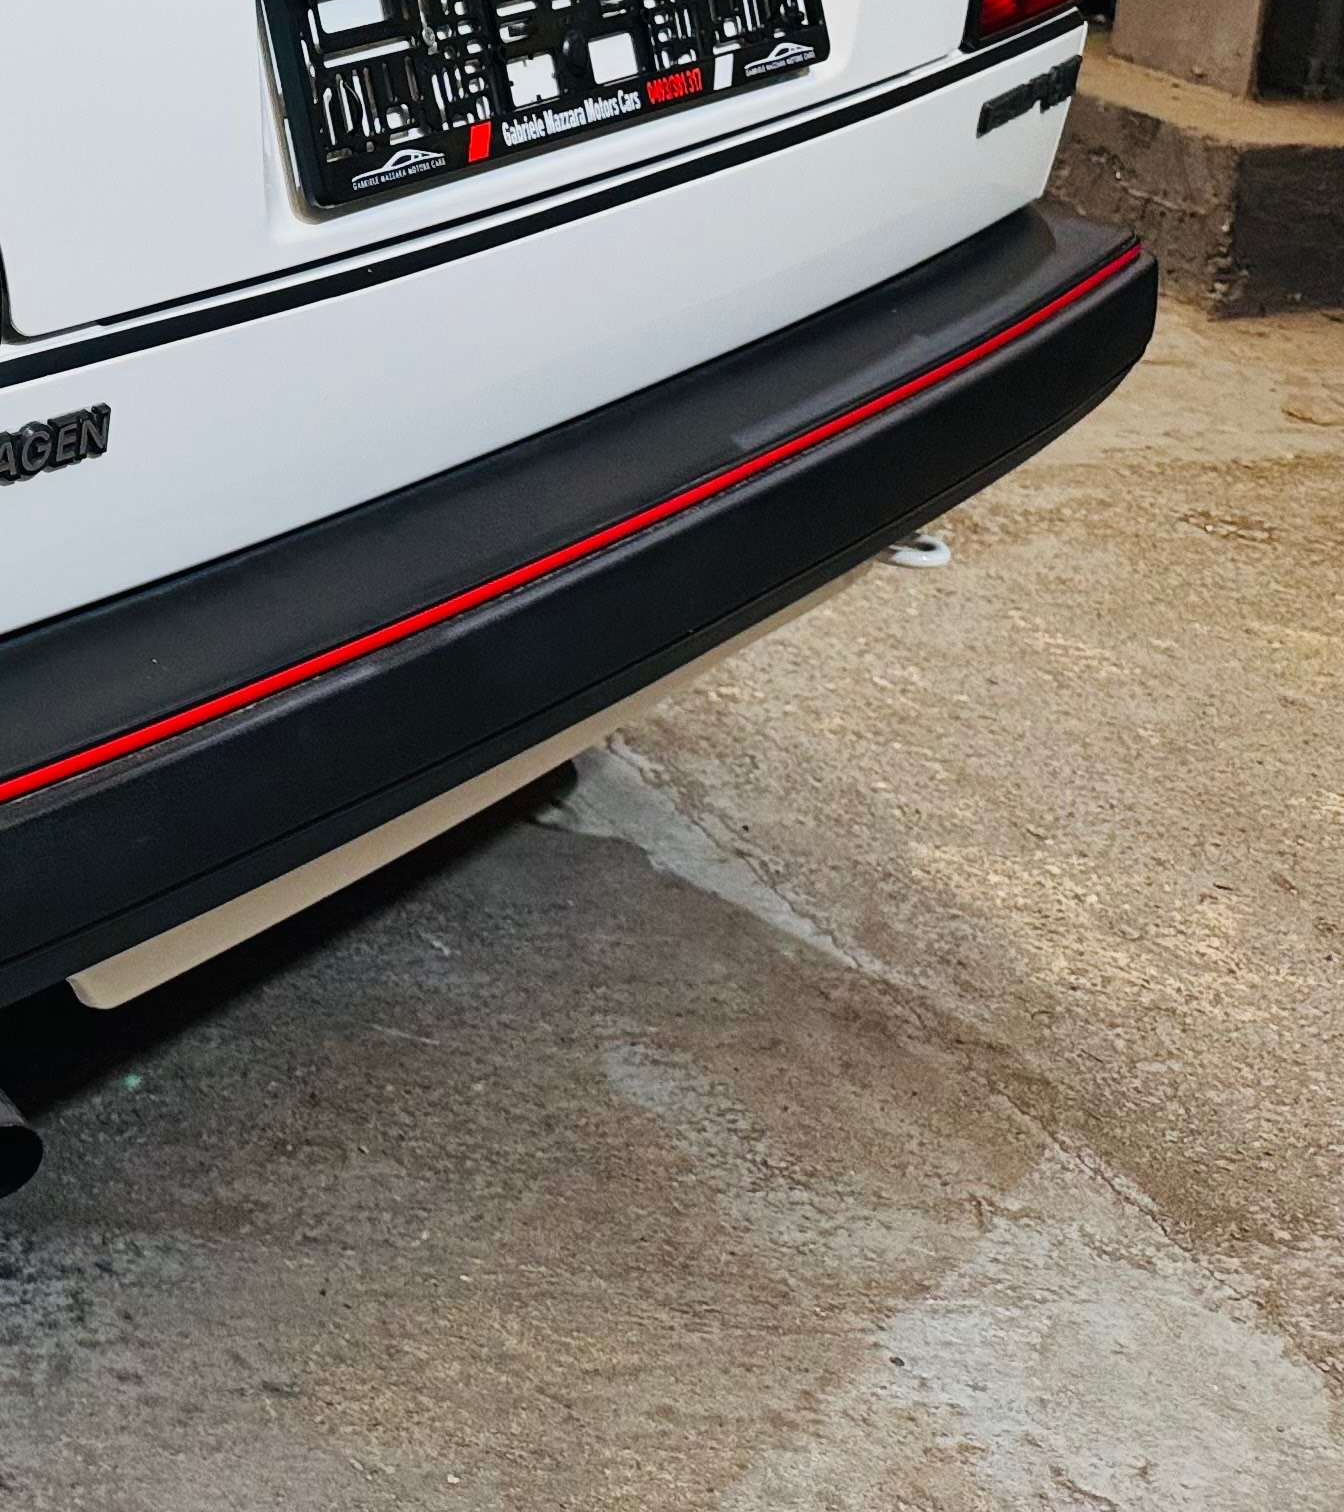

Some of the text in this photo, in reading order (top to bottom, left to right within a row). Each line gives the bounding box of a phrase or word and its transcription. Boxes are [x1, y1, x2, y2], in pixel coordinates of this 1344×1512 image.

[502, 114, 545, 146] Gabriele
[543, 105, 586, 135] Mazzara
[584, 94, 620, 123] Motors
[618, 90, 641, 115] Cars
